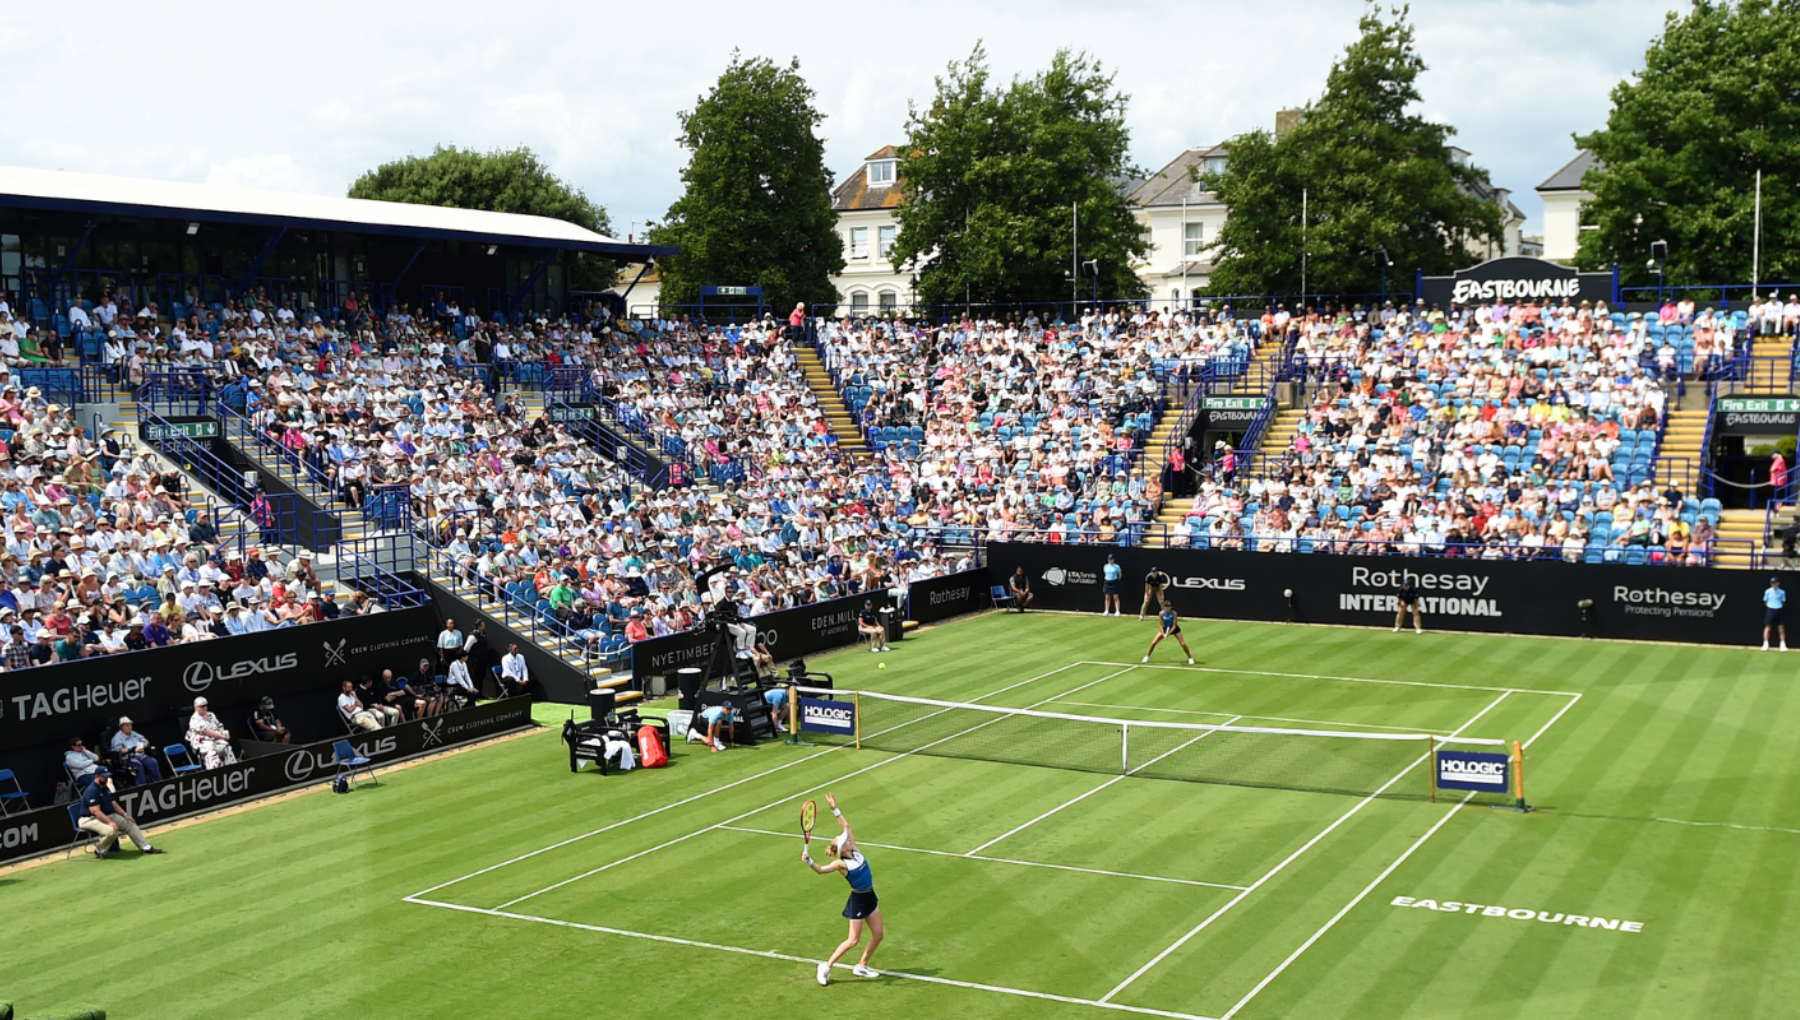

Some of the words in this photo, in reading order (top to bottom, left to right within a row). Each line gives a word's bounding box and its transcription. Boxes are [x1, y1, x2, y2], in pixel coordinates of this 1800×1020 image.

[1452, 278, 1580, 304] EASTBOURNE
[1226, 398, 1243, 408] Exit
[1722, 400, 1744, 410] Fire
[1747, 400, 1769, 410] Exit
[1726, 413, 1796, 426] EASTBOURNE
[1172, 576, 1246, 590] LEXUS
[1352, 566, 1489, 596] Rothesay
[930, 586, 970, 606] Rothesay
[1339, 593, 1502, 617] INTERATIONAL
[1613, 585, 1726, 610] Rothesay
[1625, 604, 1671, 618] Protecting
[1673, 607, 1714, 618] Pensions
[351, 646, 368, 655] CREW
[370, 639, 400, 652] CLOTHING
[401, 635, 429, 646] COMPANY
[216, 653, 298, 680] LEXUS
[466, 717, 494, 729] CLOTHING
[496, 710, 523, 722] COMPANY
[804, 705, 852, 720] HOLOGIC
[317, 736, 397, 768] LXUS
[1441, 759, 1505, 775] HOLOGIC
[0, 822, 38, 849] OM
[1390, 896, 1645, 933] EASTBOURNE
